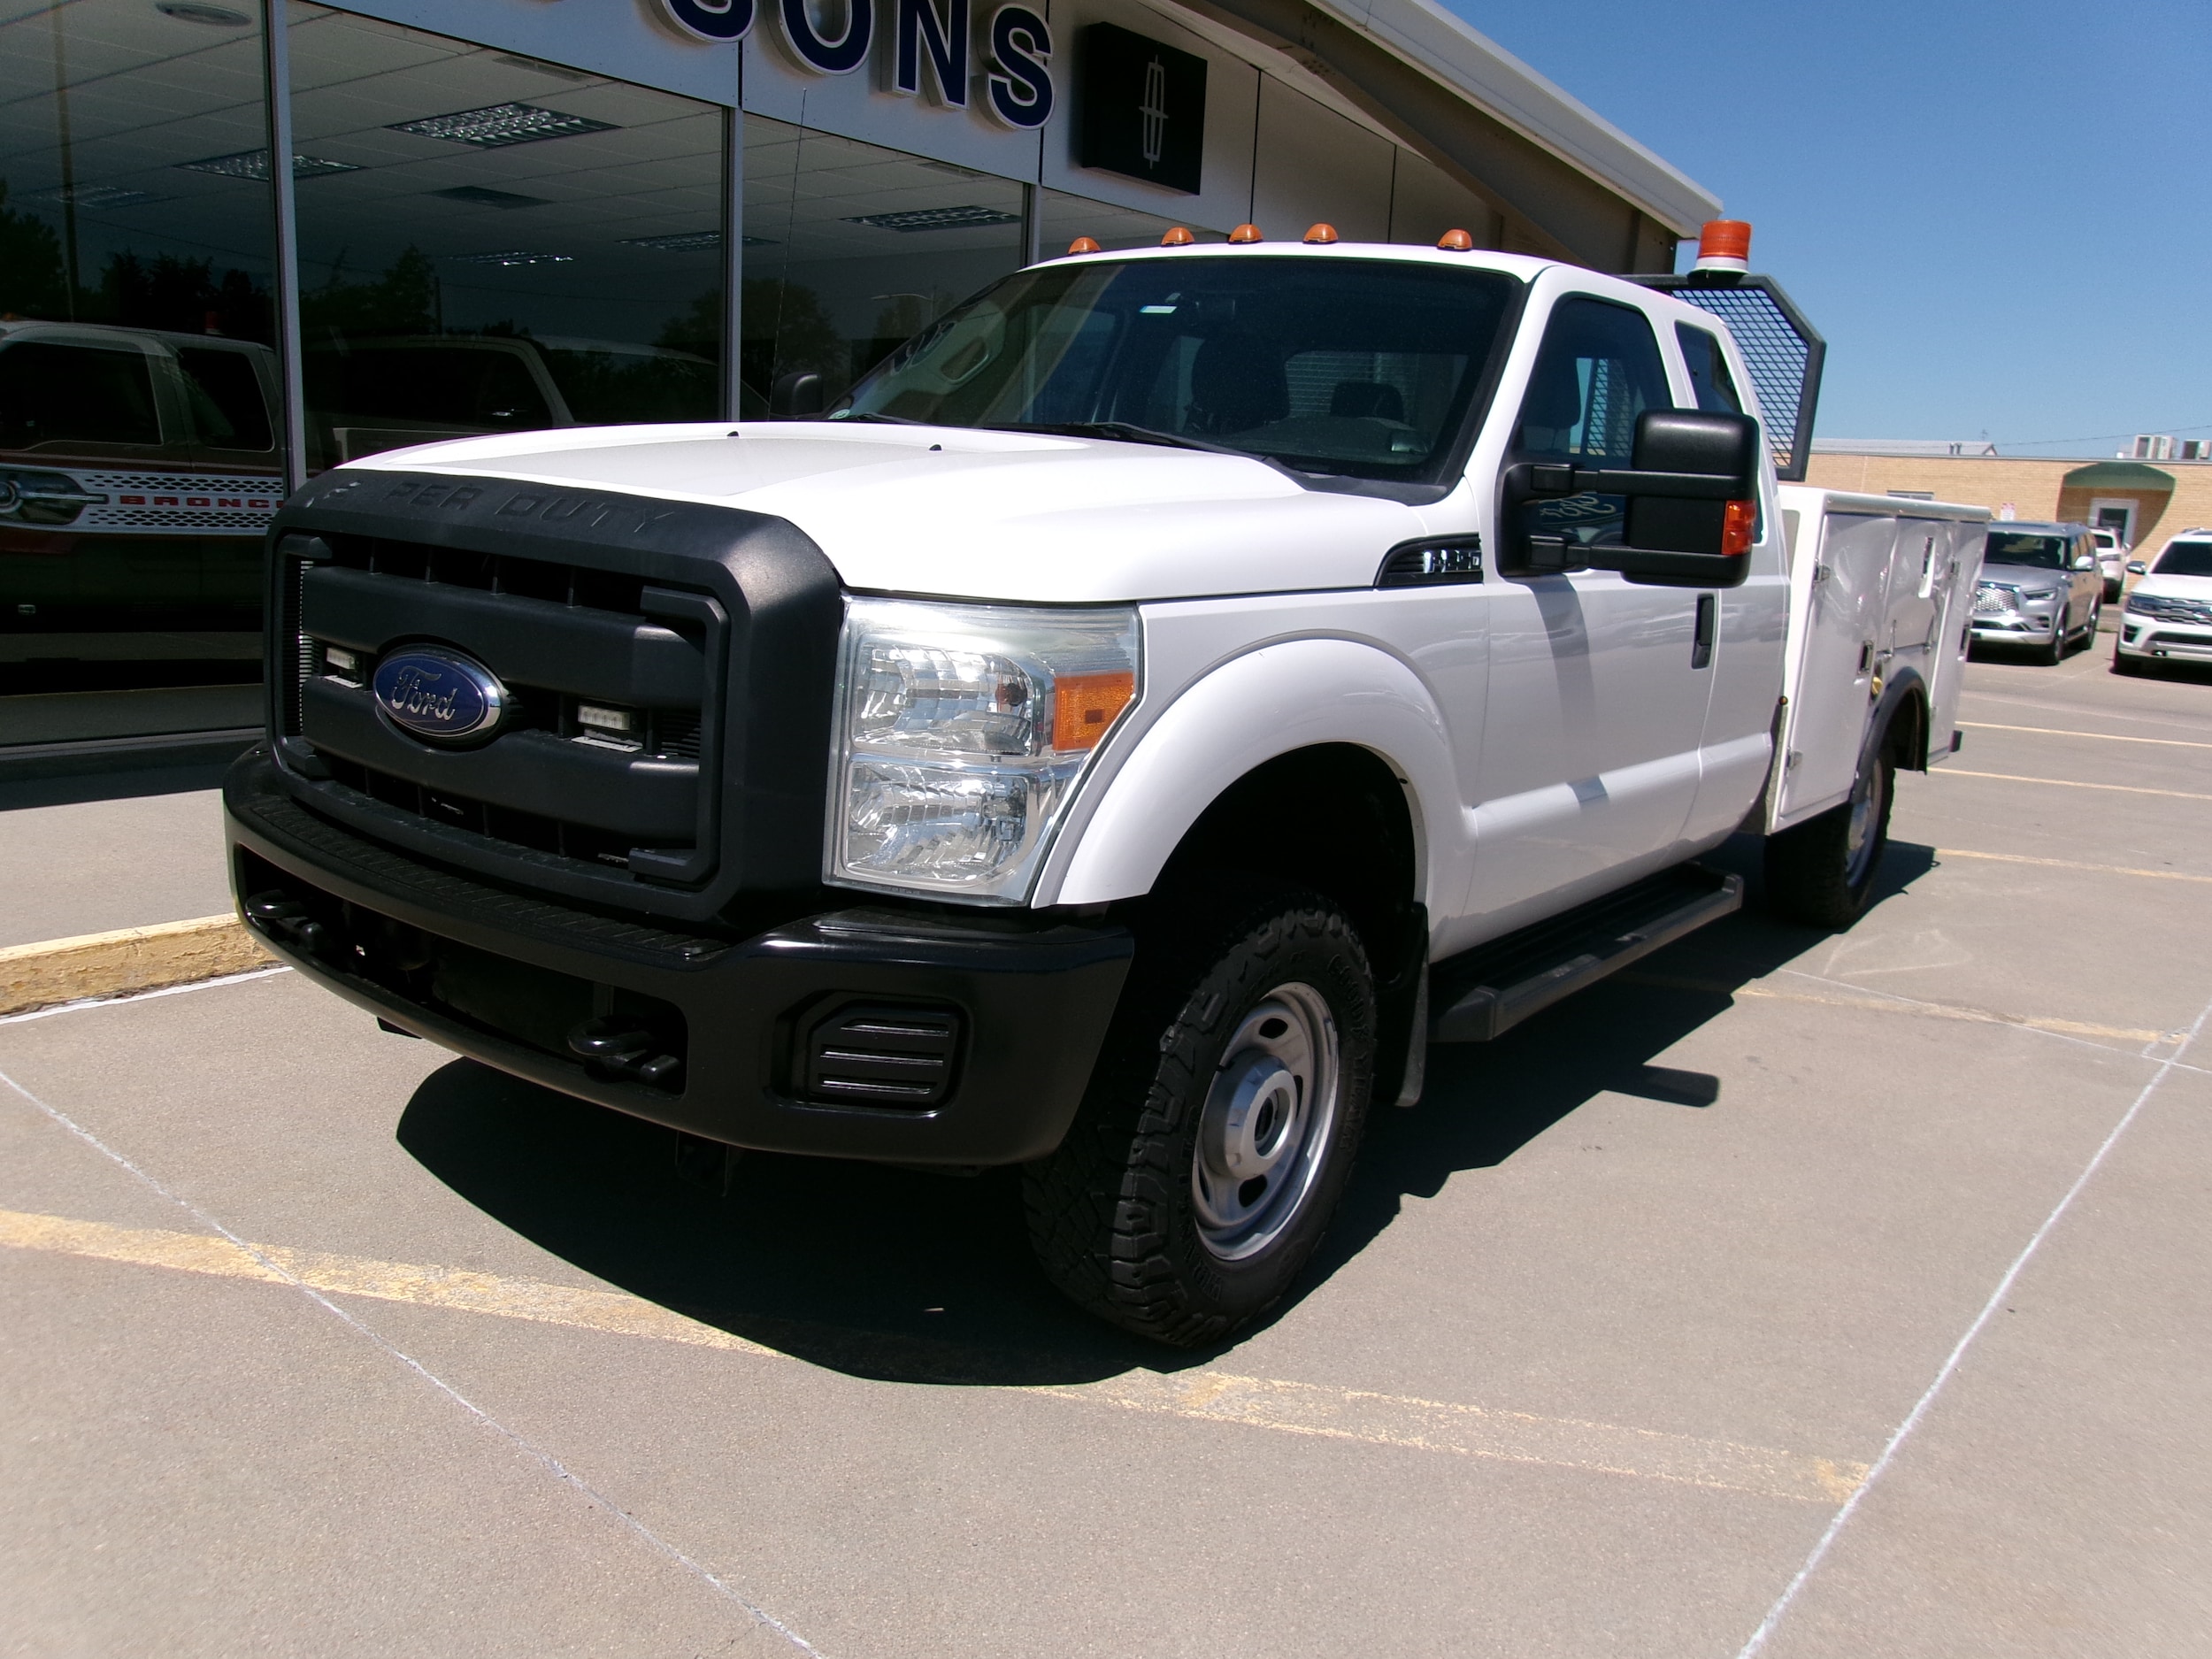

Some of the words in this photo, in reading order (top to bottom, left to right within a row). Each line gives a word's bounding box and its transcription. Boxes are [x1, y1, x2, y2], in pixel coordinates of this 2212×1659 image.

[662, 0, 1055, 131] ONS
[495, 491, 676, 534] DUTY
[390, 664, 458, 721] Ford
